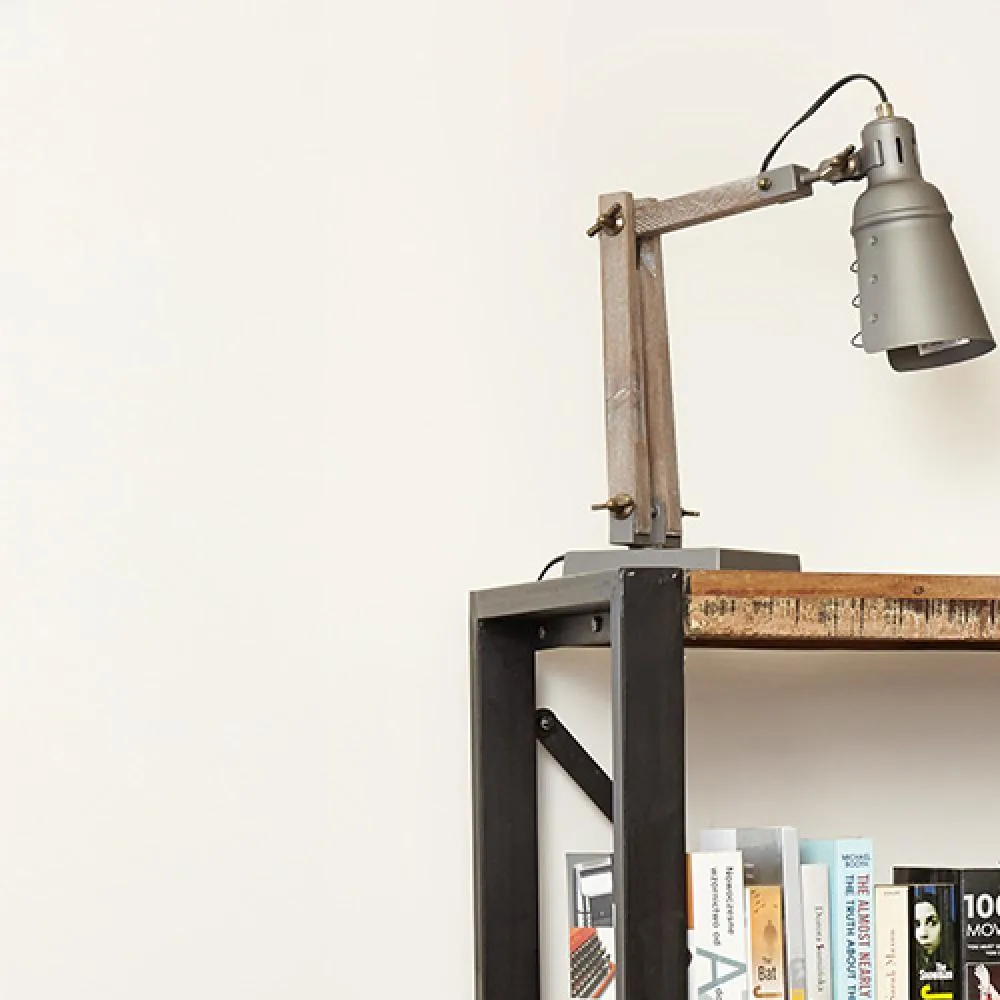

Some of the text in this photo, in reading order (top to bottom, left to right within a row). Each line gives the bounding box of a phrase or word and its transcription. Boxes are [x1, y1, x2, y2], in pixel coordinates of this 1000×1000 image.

[845, 874, 855, 896] THE
[857, 874, 870, 896] THE
[846, 899, 857, 936] TRUTH
[857, 899, 871, 947] ALMOST
[846, 939, 857, 979] ABOUT
[858, 951, 873, 999] NEARLY
